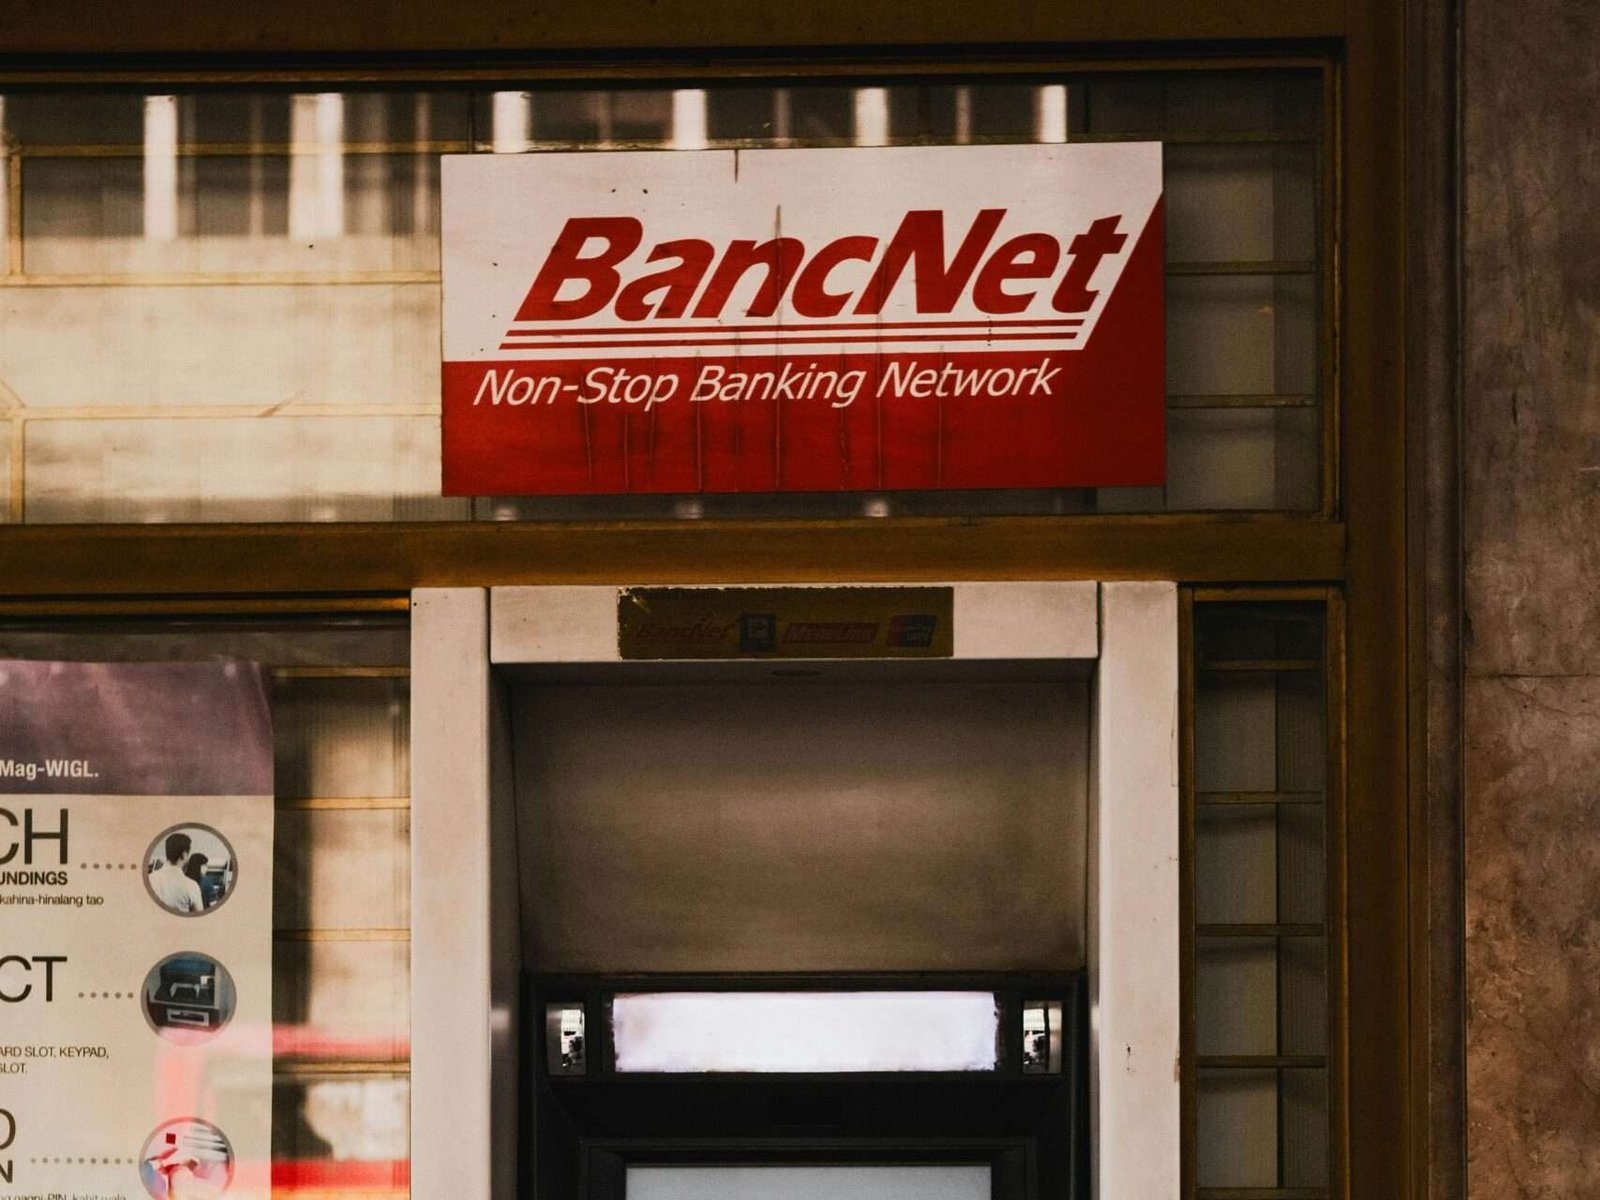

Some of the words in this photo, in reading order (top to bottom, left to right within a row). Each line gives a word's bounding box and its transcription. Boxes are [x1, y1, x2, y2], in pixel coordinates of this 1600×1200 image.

[513, 208, 1128, 321] BancNet
[473, 366, 679, 411] Non-Stop
[690, 363, 866, 408] Banking
[876, 359, 1062, 399] Network
[0, 760, 99, 780] Mag-WIGL.
[86, 895, 104, 905] tao
[0, 955, 68, 1003] CT
[60, 1046, 109, 1060] KEYPAD,
